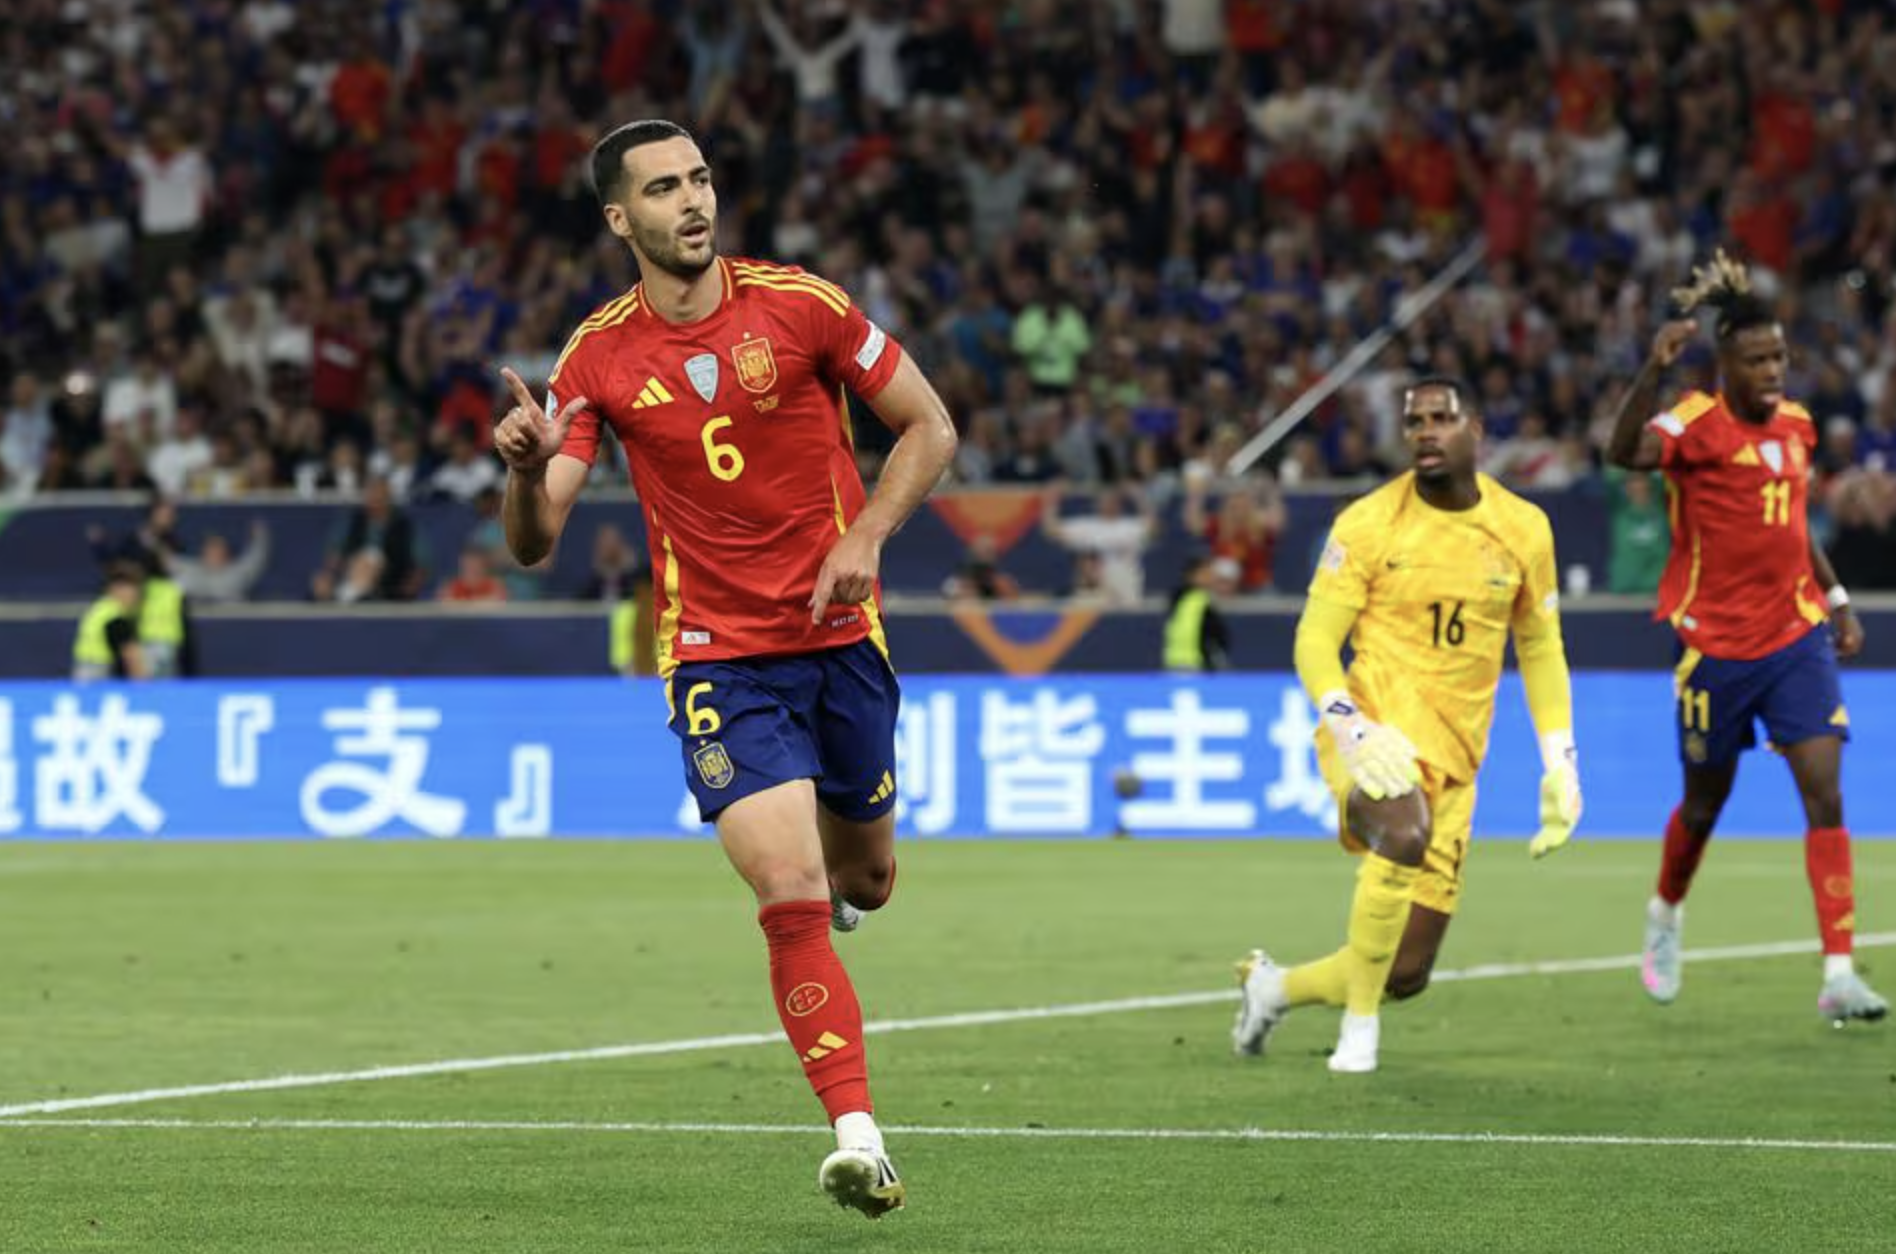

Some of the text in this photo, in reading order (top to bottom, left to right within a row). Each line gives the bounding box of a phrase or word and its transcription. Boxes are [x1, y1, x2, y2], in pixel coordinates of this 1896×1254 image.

[701, 415, 745, 482] 6
[1760, 480, 1791, 527] 11
[1427, 600, 1465, 648] 16
[685, 682, 721, 736] 6
[1683, 686, 1710, 732] 11
